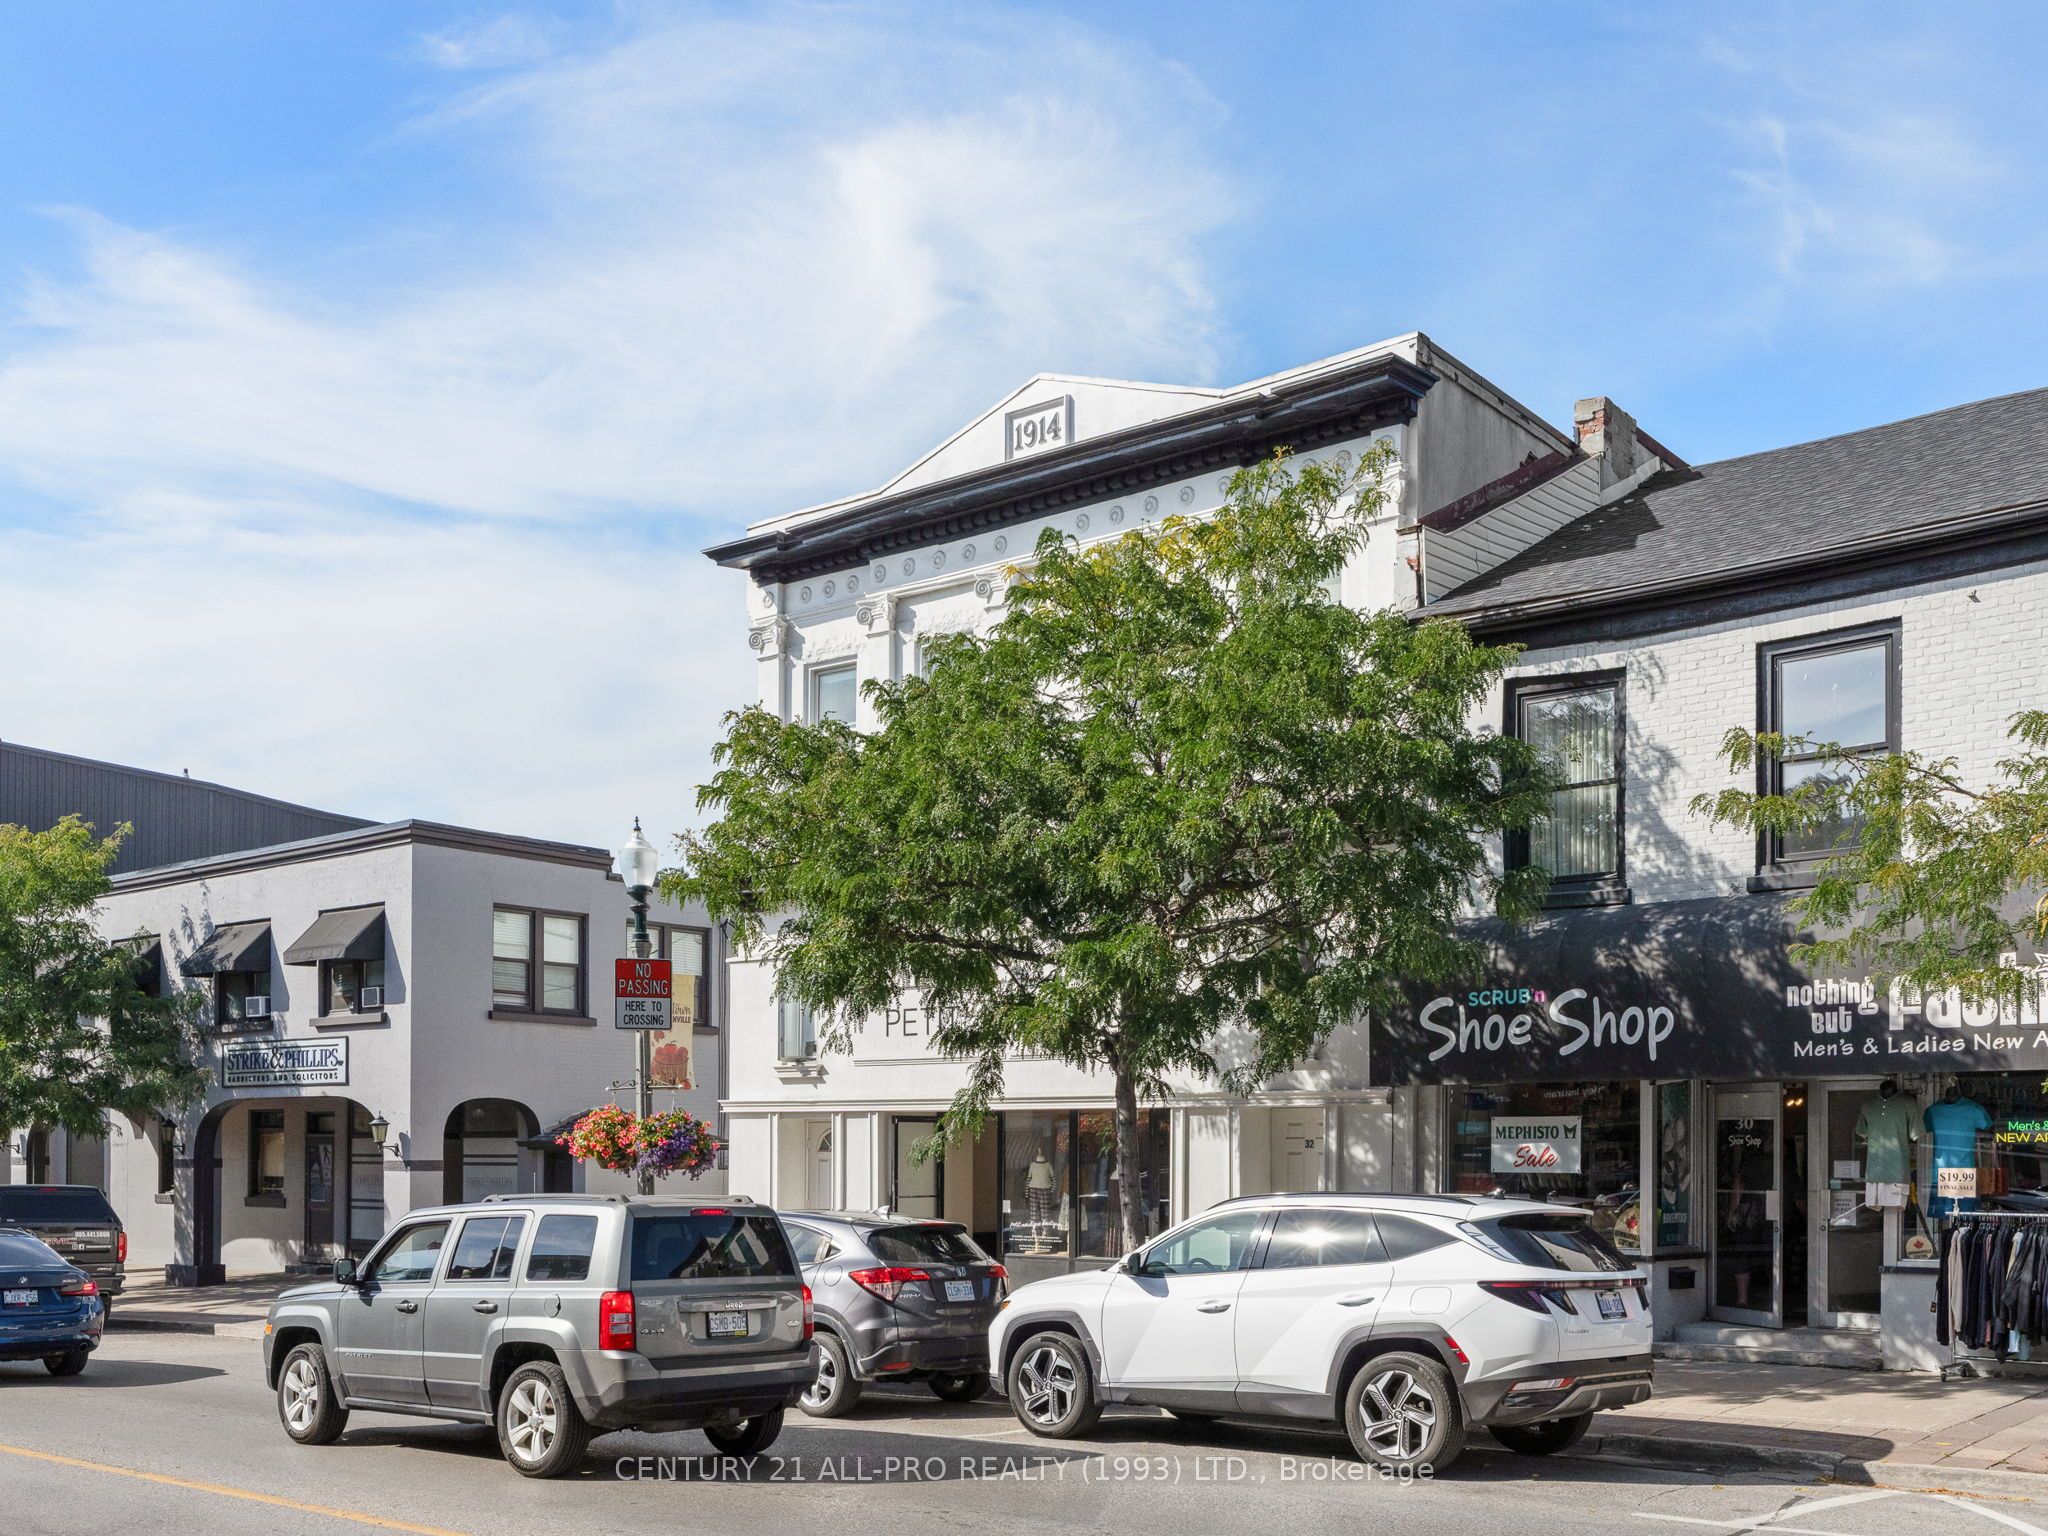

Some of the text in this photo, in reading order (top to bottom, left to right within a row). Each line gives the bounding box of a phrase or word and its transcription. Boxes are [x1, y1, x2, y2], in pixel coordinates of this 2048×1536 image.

[1015, 411, 1061, 451] 1914
[635, 963, 652, 978] NO
[619, 979, 668, 995] PASSING
[1468, 988, 1546, 1007] SCRUB'n
[1786, 976, 1880, 1016] nothing
[625, 1001, 662, 1012] HERE TO
[623, 1014, 664, 1026] CROSSING
[1419, 988, 1675, 1062] Shoe Shop
[1793, 1038, 1854, 1058] Men's
[1863, 1037, 1879, 1055] &
[1887, 1035, 1966, 1054] Ladies
[1973, 1032, 2025, 1051] New
[292, 1072, 338, 1080] SOLICITORS
[1735, 1117, 1754, 1130] 30
[2008, 1120, 2041, 1131] Men's
[1495, 1125, 1559, 1140] MEPHISTO
[1996, 1132, 2031, 1143] NEW
[1304, 1139, 1315, 1149] 32
[1728, 1134, 1762, 1148] Shoe Shop
[1513, 1144, 1558, 1168] Sale
[1939, 1172, 1975, 1184] $19.99
[725, 1300, 744, 1309] Jeep
